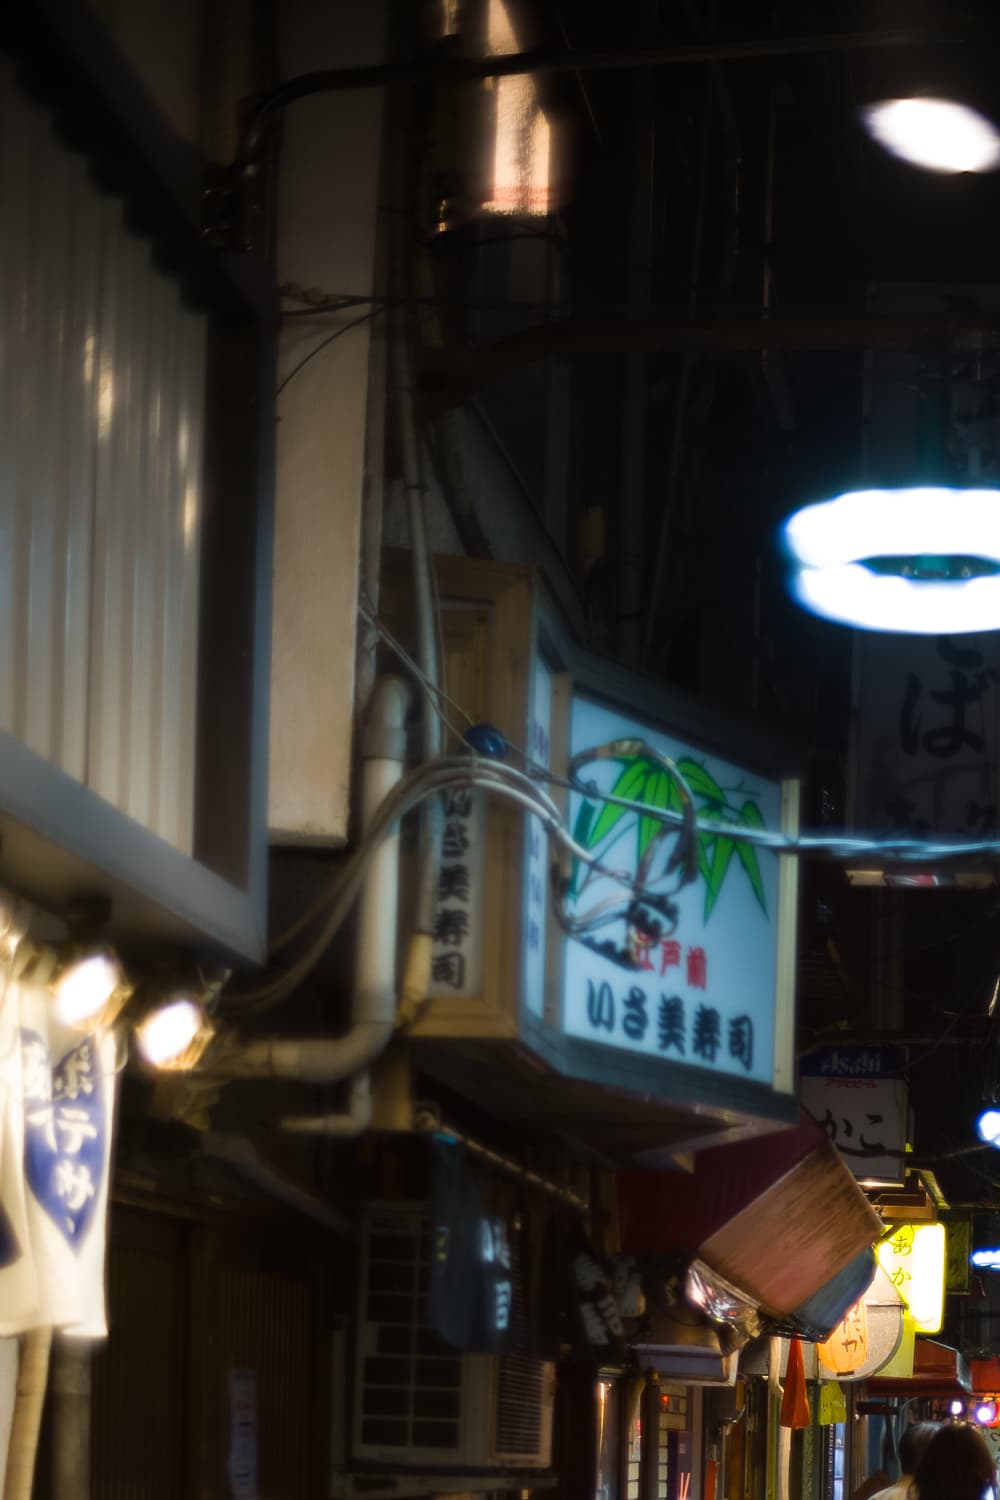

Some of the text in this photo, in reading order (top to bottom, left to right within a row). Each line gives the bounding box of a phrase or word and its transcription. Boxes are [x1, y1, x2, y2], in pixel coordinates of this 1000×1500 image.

[586, 978, 755, 1073] いさ美寿司
[820, 1050, 881, 1074] Asahi
